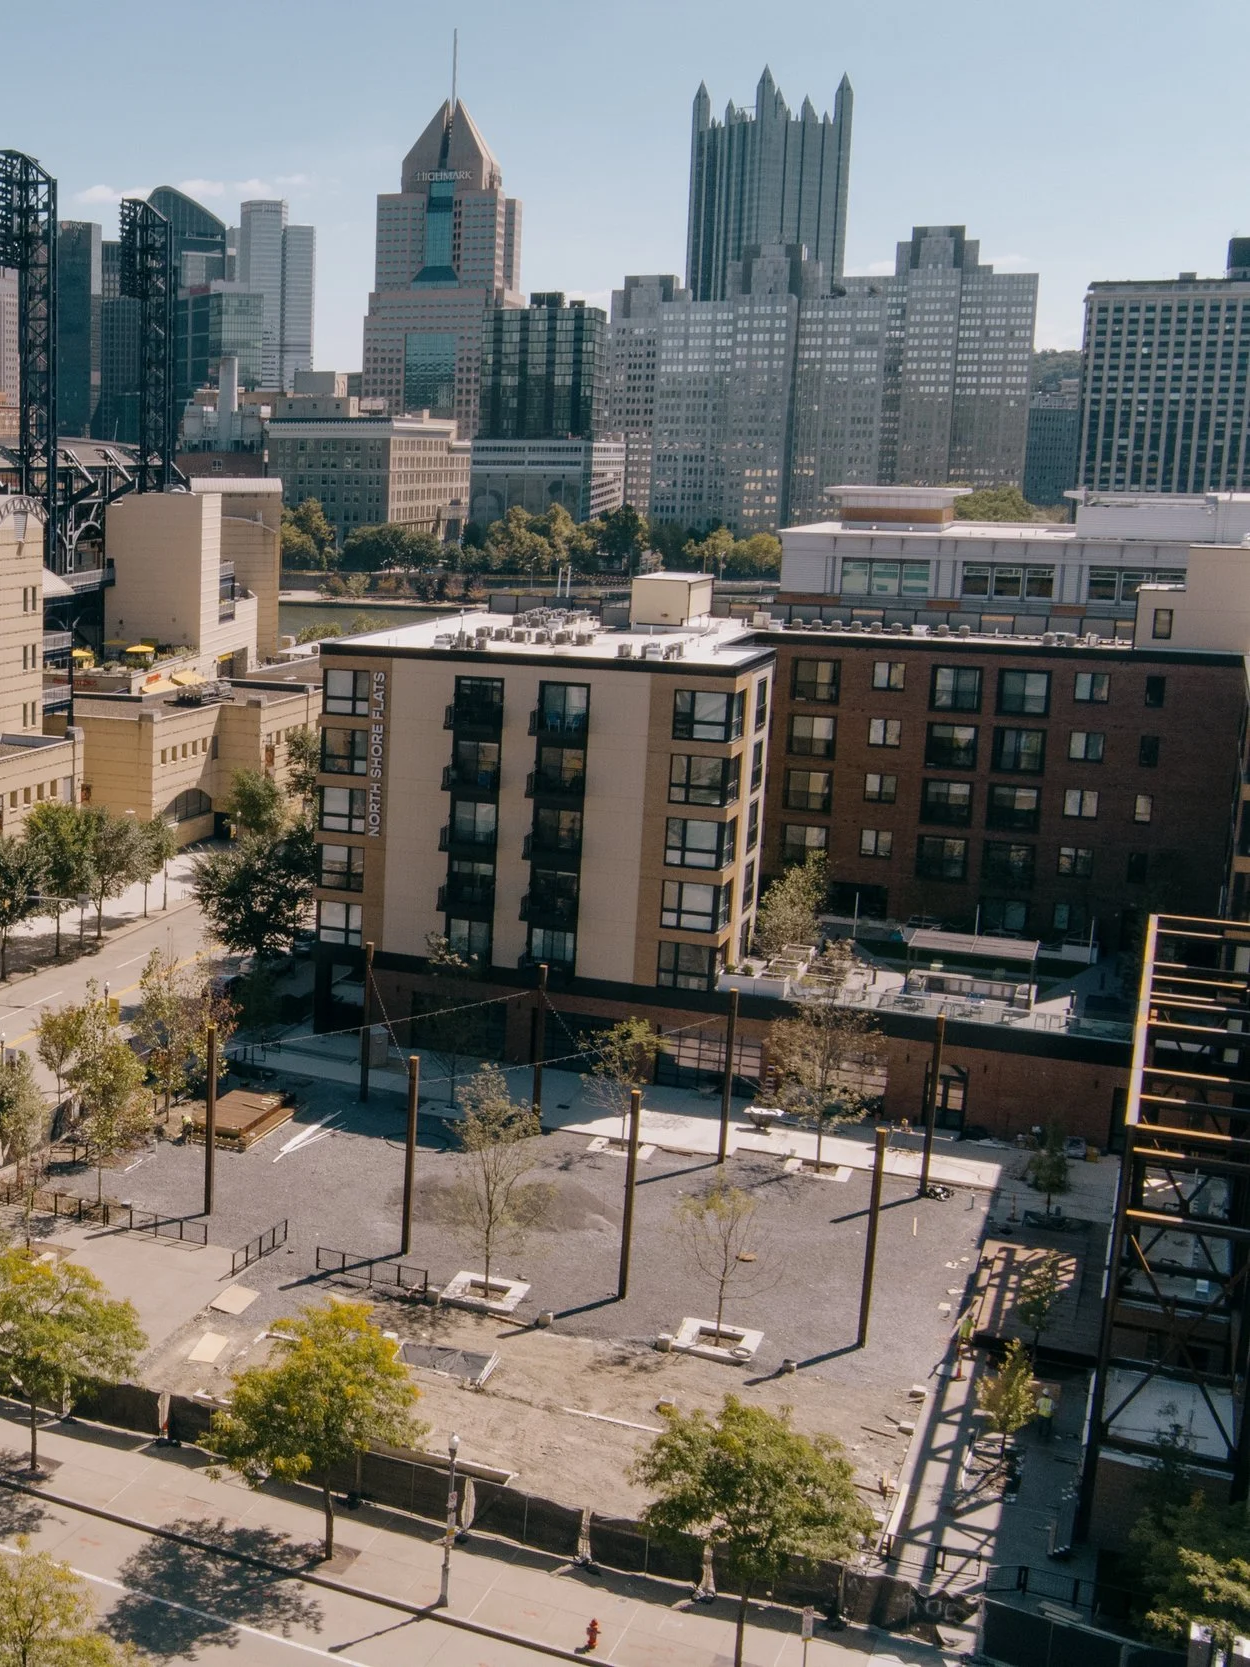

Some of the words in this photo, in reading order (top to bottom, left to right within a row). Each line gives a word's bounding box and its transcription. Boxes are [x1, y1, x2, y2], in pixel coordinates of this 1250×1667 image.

[417, 170, 473, 181] HIGHMARK
[372, 672, 385, 720] FLATS
[370, 724, 384, 778] SHORE
[368, 783, 382, 837] NORTH
